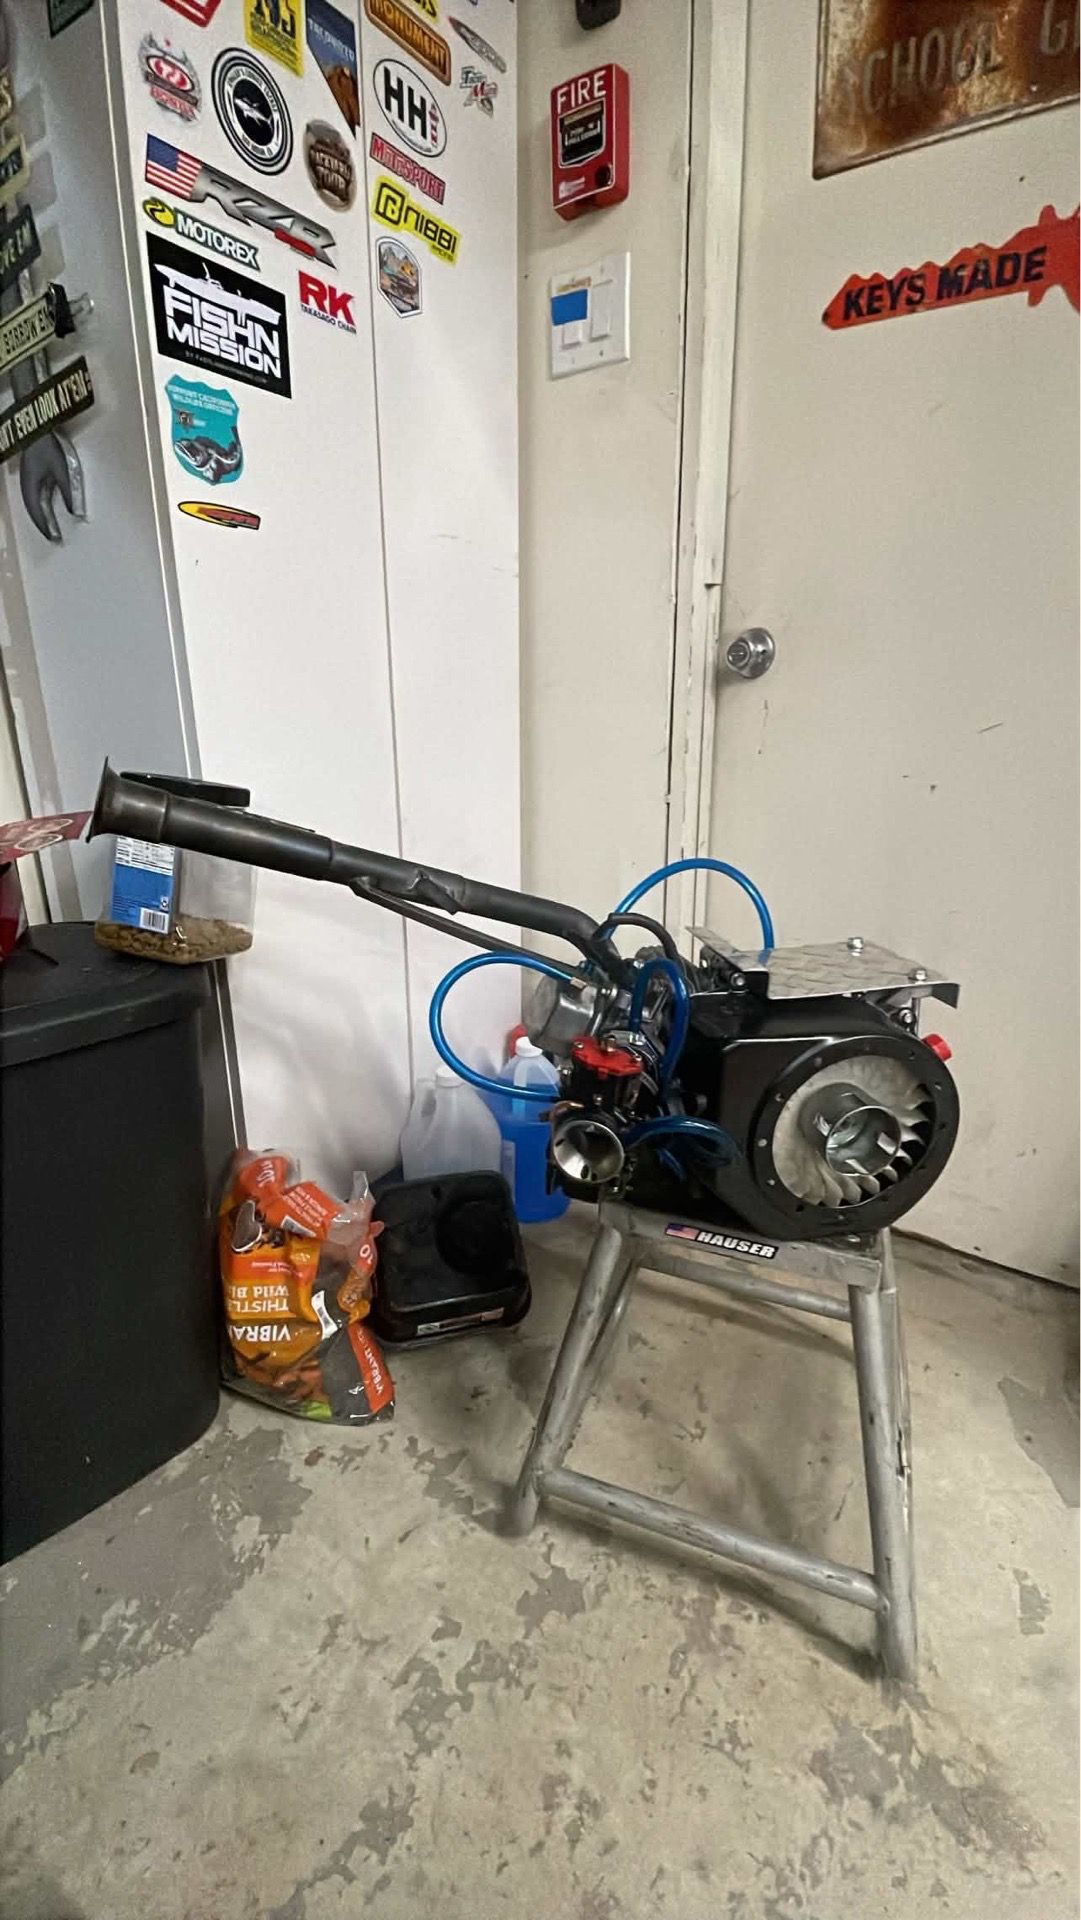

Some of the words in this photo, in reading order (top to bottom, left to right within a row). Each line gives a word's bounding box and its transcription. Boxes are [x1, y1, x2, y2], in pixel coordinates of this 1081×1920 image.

[383, 66, 427, 139] HH
[557, 70, 606, 114] FIRE
[177, 213, 256, 268] MOTOREX
[298, 270, 355, 326] RK
[842, 273, 926, 321] KEYS
[936, 246, 1048, 300] MADE
[163, 285, 280, 359] FISHN
[166, 315, 281, 379] MISSION
[14, 403, 39, 440] EVEN
[34, 388, 60, 425] LOOK
[697, 1231, 776, 1258] HAUSER
[253, 1285, 290, 1298] Wild
[228, 1324, 291, 1342] VIBRA
